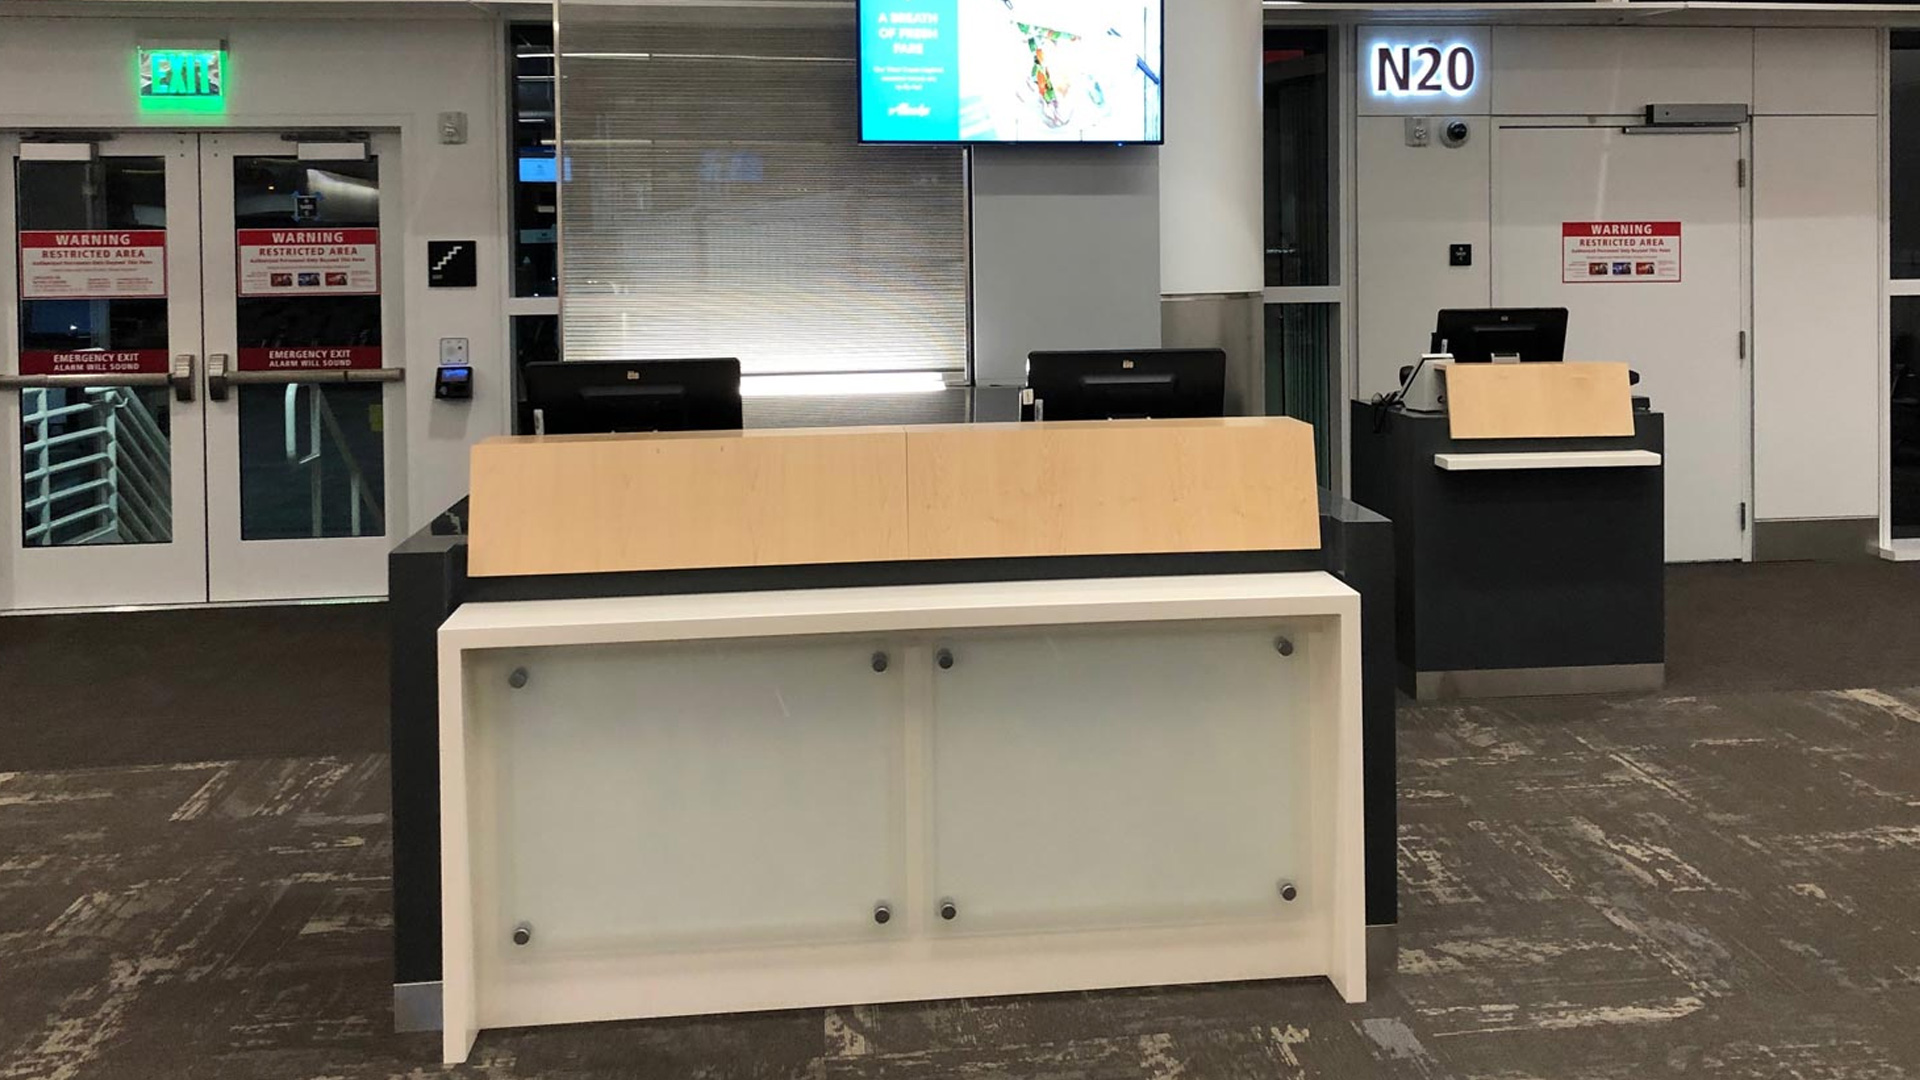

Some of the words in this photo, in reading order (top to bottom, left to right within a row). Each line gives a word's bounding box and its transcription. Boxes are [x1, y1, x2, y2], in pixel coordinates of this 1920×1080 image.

[878, 12, 888, 23] A
[878, 27, 895, 39] OF
[151, 52, 214, 94] EXIT
[1378, 46, 1474, 91] N20
[1590, 224, 1652, 235] WARNING
[55, 234, 131, 246] WARNING
[271, 232, 344, 244] WARNING
[1579, 238, 1636, 247] RESTRICTED
[1639, 238, 1665, 246] AREA
[41, 249, 111, 259] RESTRICTED
[115, 249, 145, 258] AREA
[258, 247, 325, 256] RESTRICTED
[329, 246, 358, 256] AREA
[53, 353, 115, 363] EMERGENCY
[117, 353, 139, 361] EXIT
[268, 350, 327, 359] EMERGENCY
[330, 349, 351, 358] EXIT
